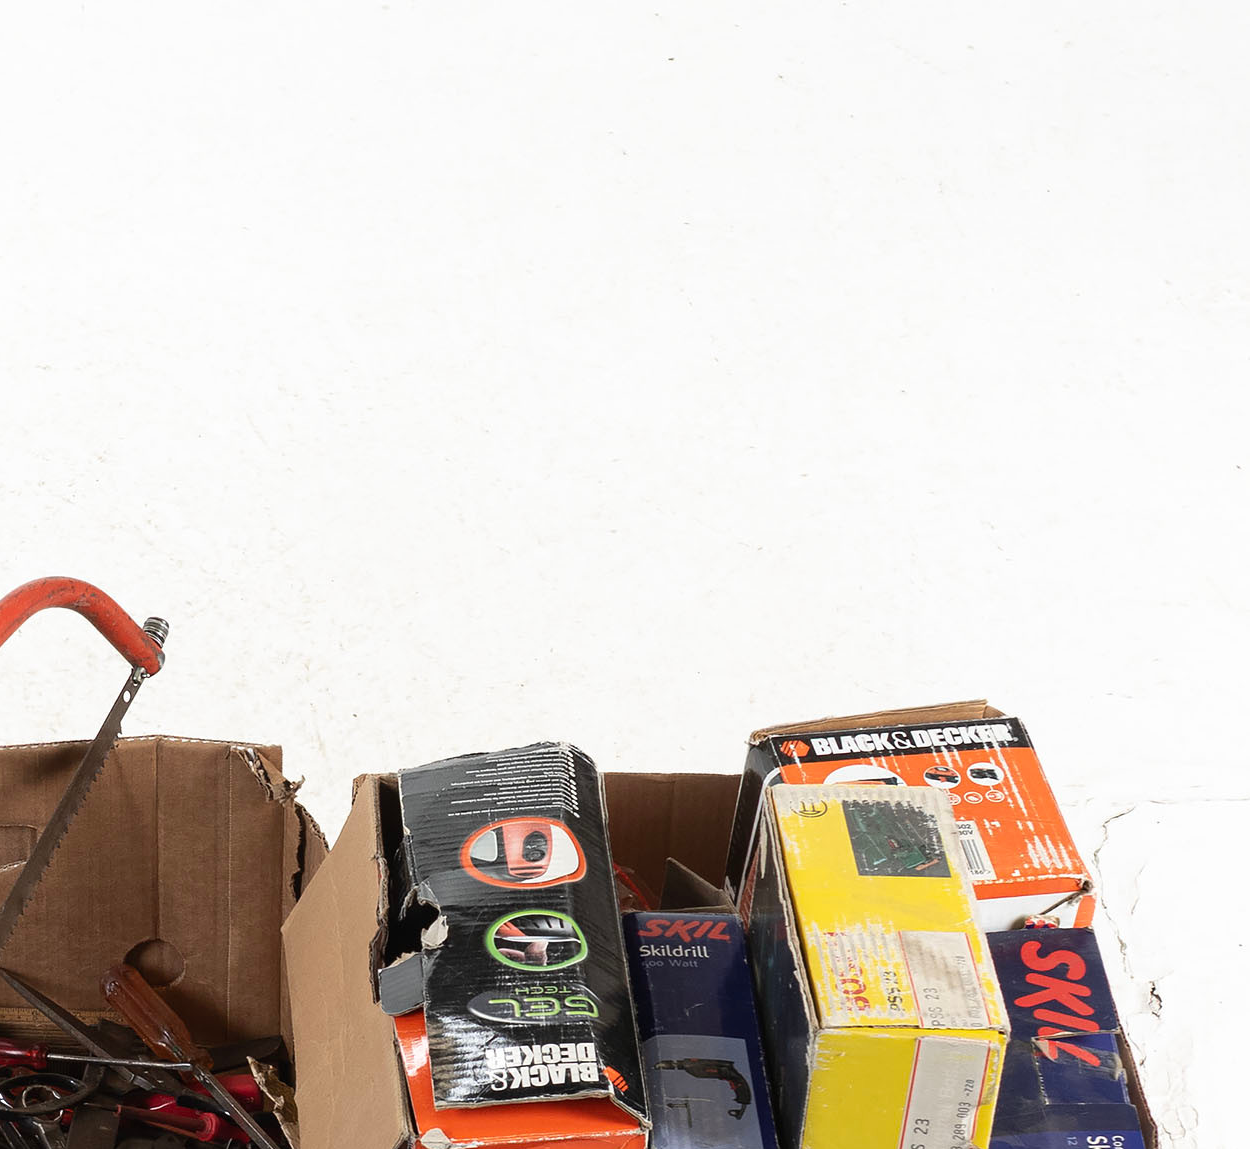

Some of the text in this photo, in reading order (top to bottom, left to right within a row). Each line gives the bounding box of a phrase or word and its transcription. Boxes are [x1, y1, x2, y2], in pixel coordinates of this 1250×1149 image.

[638, 920, 731, 943] SKIL
[640, 945, 710, 958] Skildrill
[515, 987, 572, 995] TECH
[489, 996, 599, 1018] GEL
[924, 988, 946, 1027] PSS 23
[1014, 941, 1101, 1066] SKIL
[485, 1043, 599, 1069] DECKER
[965, 1080, 974, 1097] -720
[957, 1102, 970, 1119] 003
[914, 1119, 930, 1135] 23
[953, 1124, 966, 1140] 289
[1067, 1136, 1077, 1146] 12
